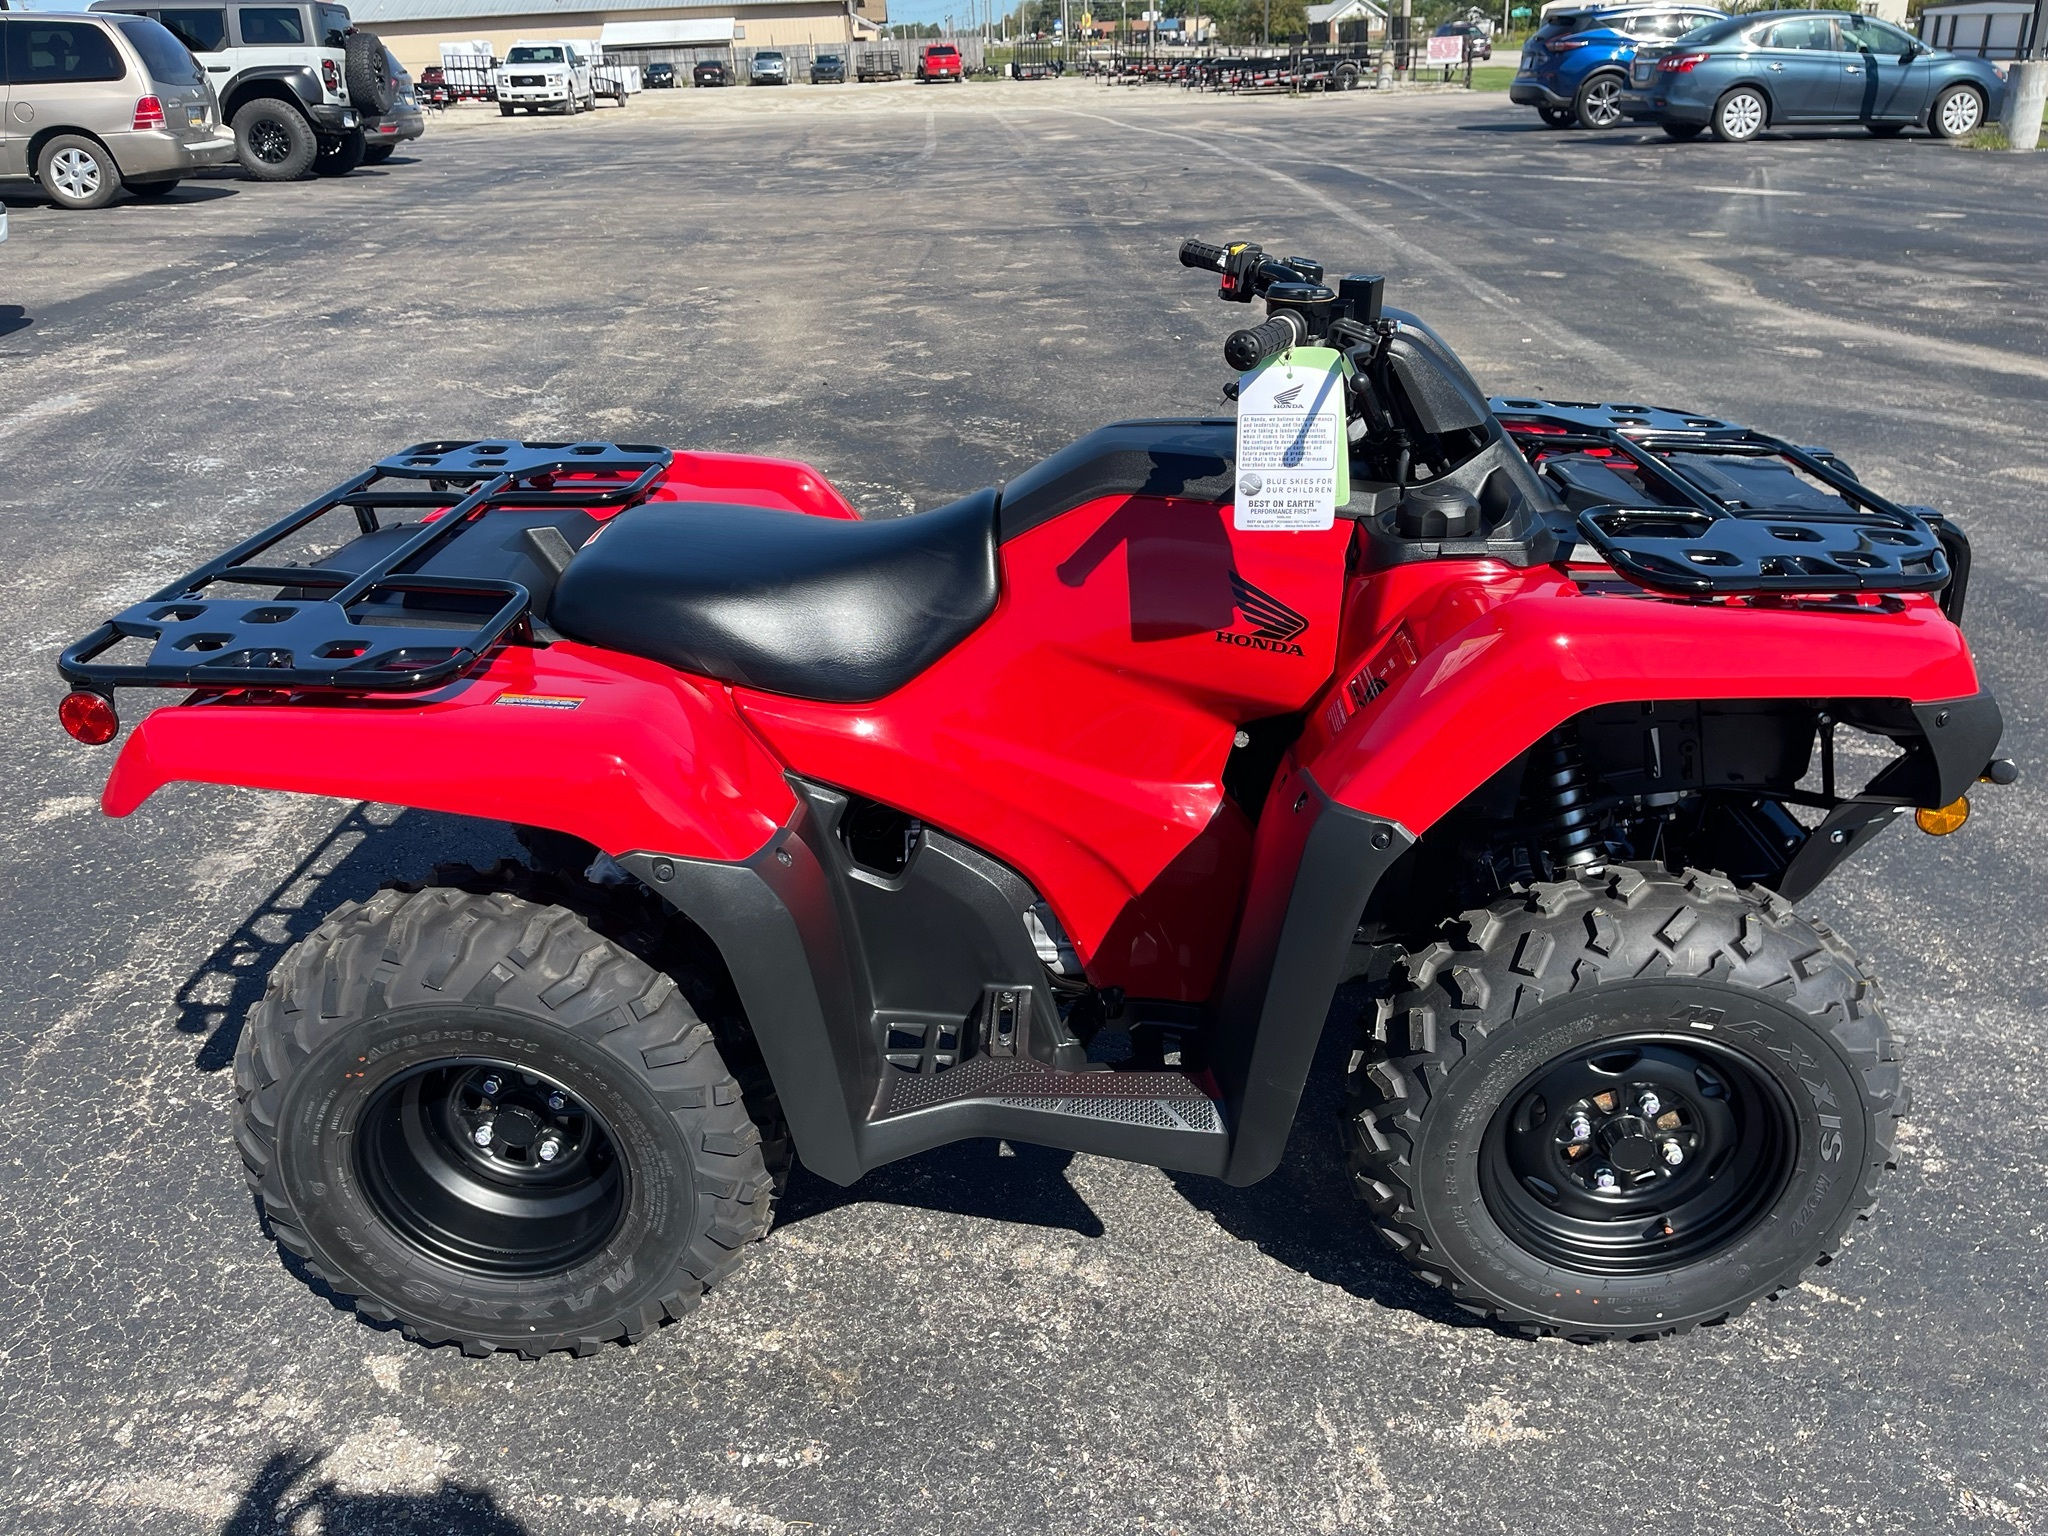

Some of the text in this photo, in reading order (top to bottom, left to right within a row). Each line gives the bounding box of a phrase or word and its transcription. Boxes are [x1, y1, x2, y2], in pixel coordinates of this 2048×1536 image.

[1215, 630, 1305, 657] HONDA
[1665, 1004, 1844, 1164] MAXXIS
[1790, 1173, 1832, 1237] M977
[335, 1225, 399, 1278] M978
[401, 1254, 636, 1320] MAXXIS
